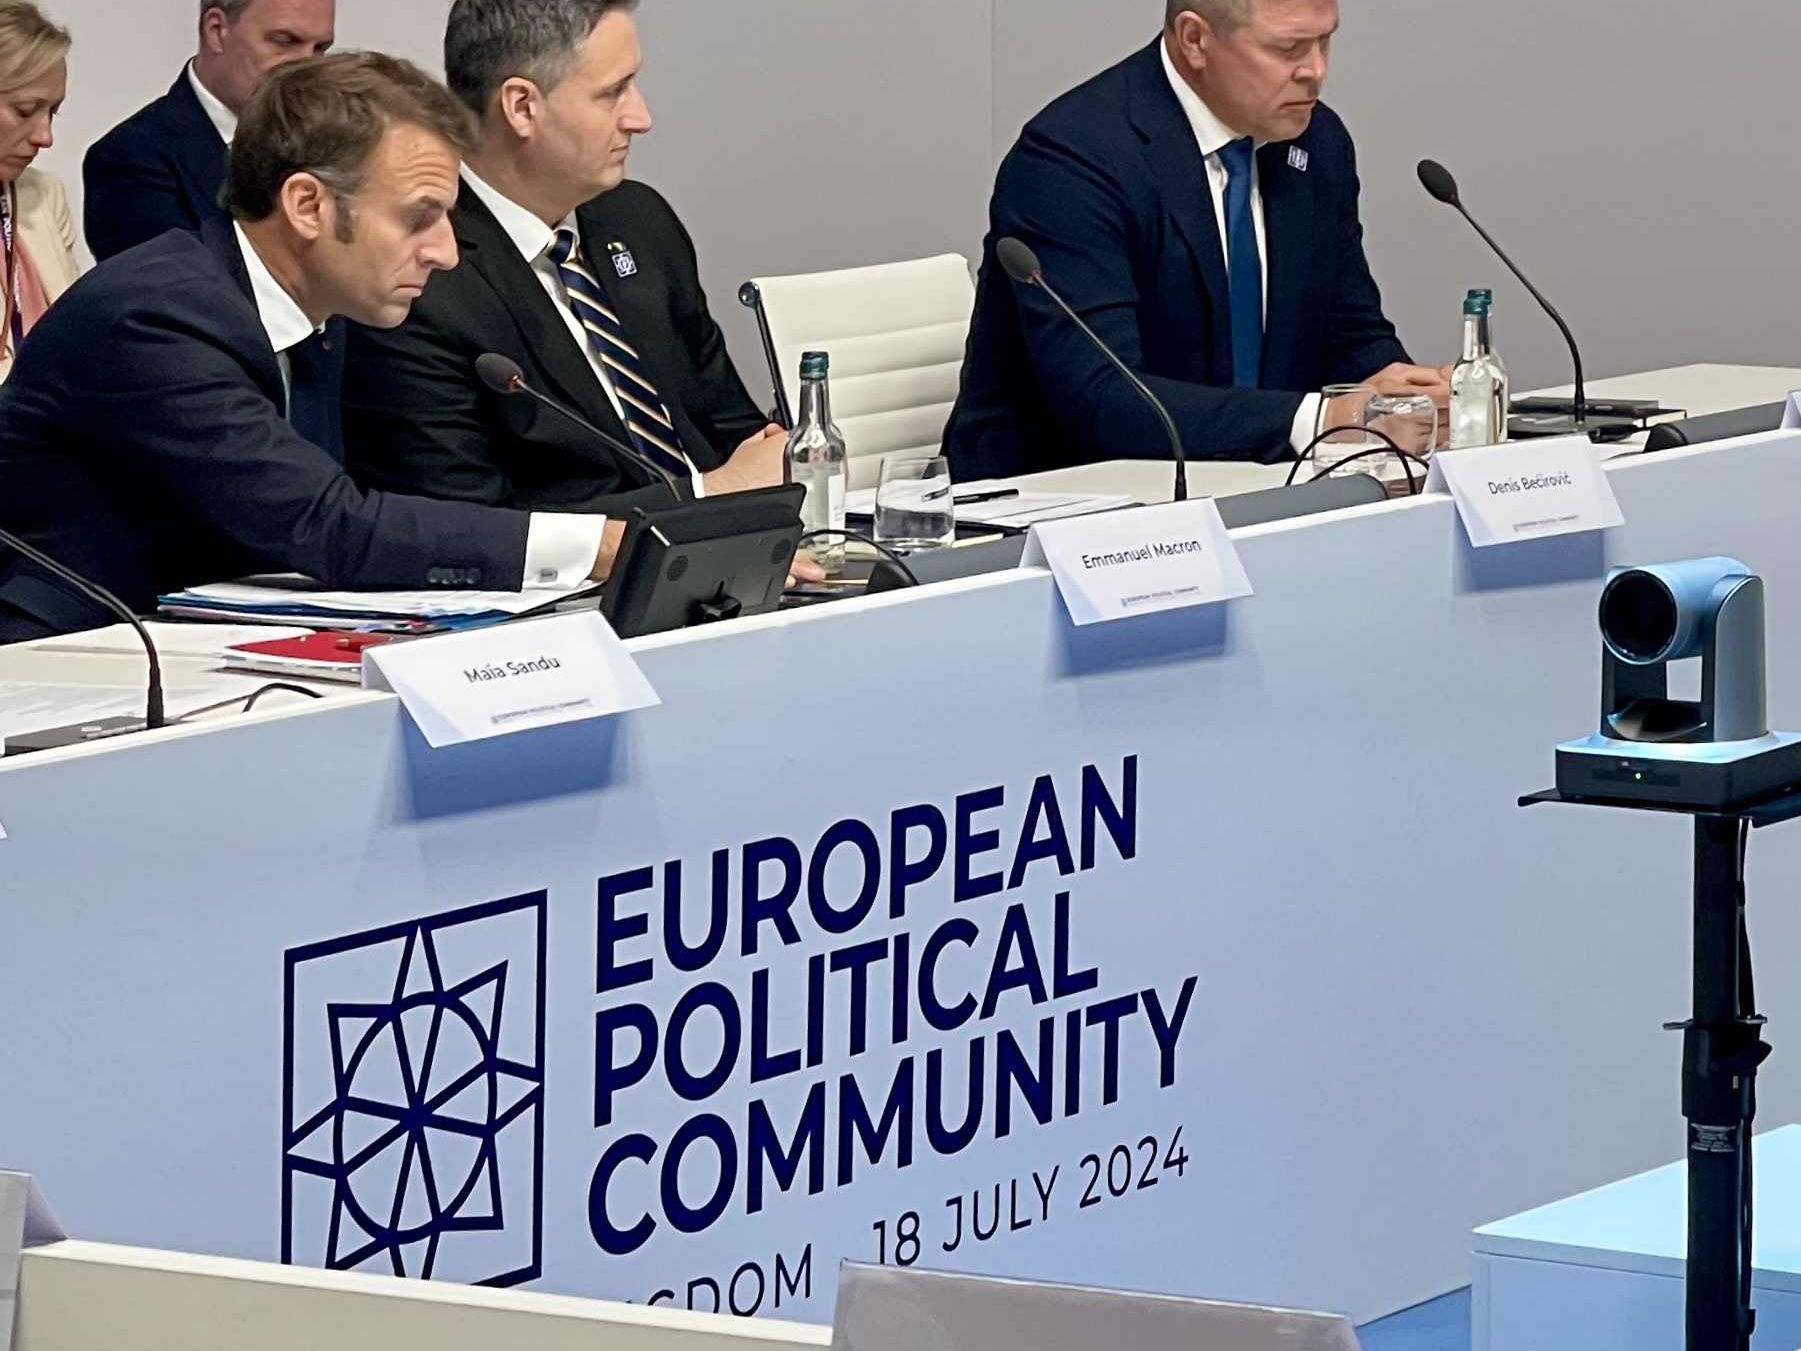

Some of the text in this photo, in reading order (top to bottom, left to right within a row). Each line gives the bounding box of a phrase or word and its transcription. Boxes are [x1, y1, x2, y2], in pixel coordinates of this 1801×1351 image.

[1082, 538, 1202, 569] Emmanuel Macron
[1487, 477, 1521, 495] Denis
[506, 655, 562, 676] Sandu
[596, 754, 1138, 994] EUROPEAN
[594, 892, 1099, 1128] POLITICAL
[588, 975, 1198, 1256] COMMUNITY
[873, 1211, 921, 1266] 18
[942, 1165, 1060, 1252] JULY
[1079, 1125, 1189, 1209] 2024
